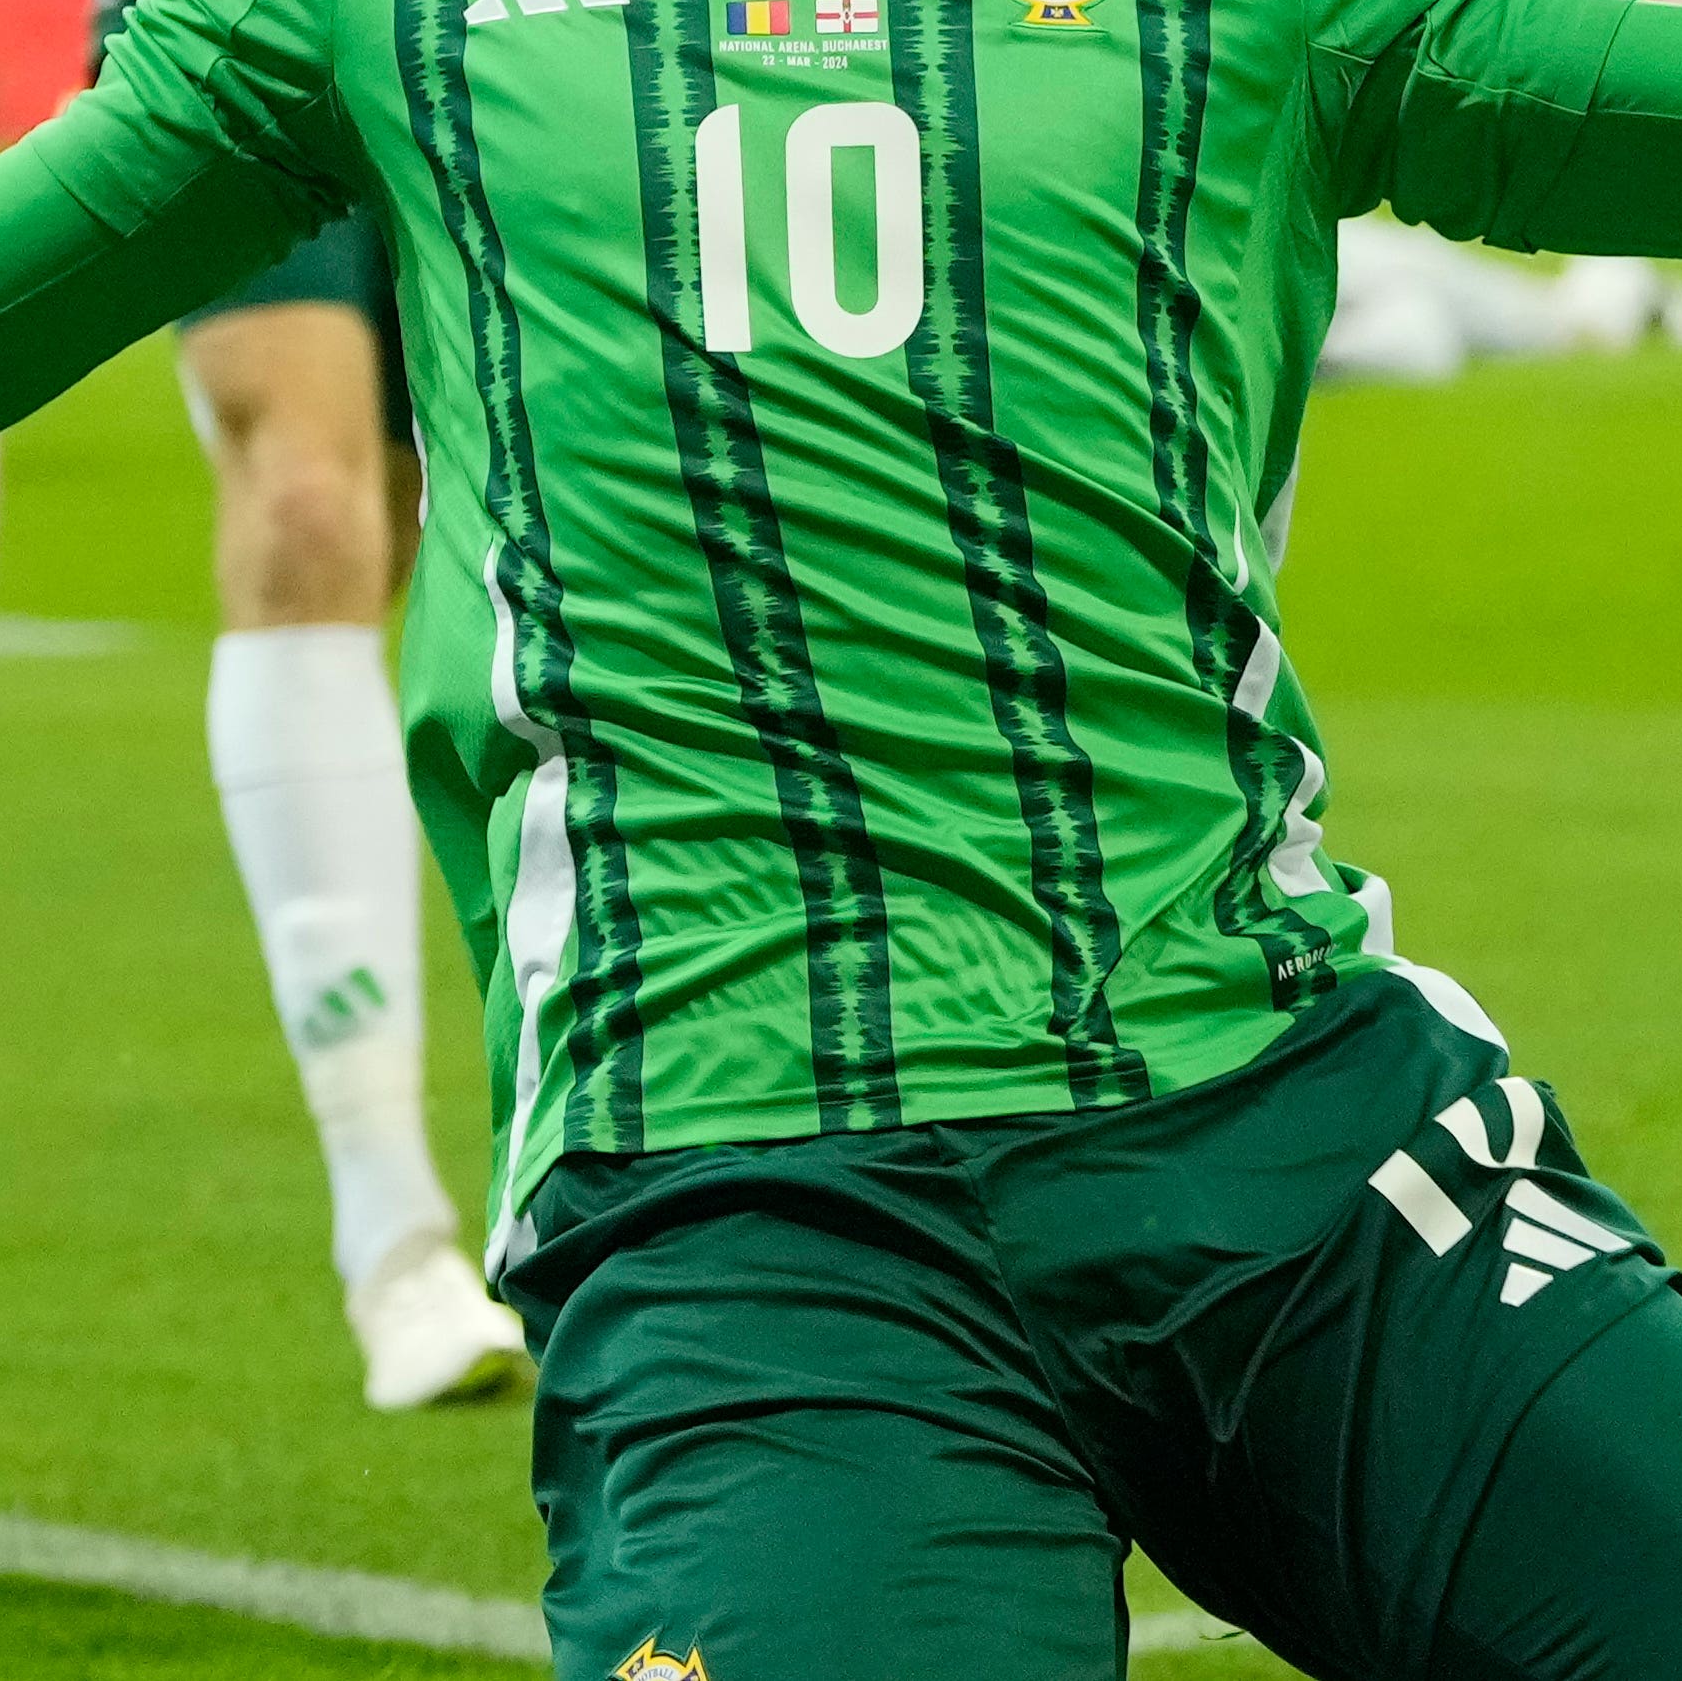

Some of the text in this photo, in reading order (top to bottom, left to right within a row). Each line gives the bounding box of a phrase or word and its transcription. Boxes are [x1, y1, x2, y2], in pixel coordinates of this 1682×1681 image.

[719, 39, 888, 54] NATIONAL ARENA, BUCHAREST
[762, 55, 775, 67] 22
[787, 56, 811, 68] MAR
[822, 55, 848, 70] 2024
[694, 101, 924, 358] 10
